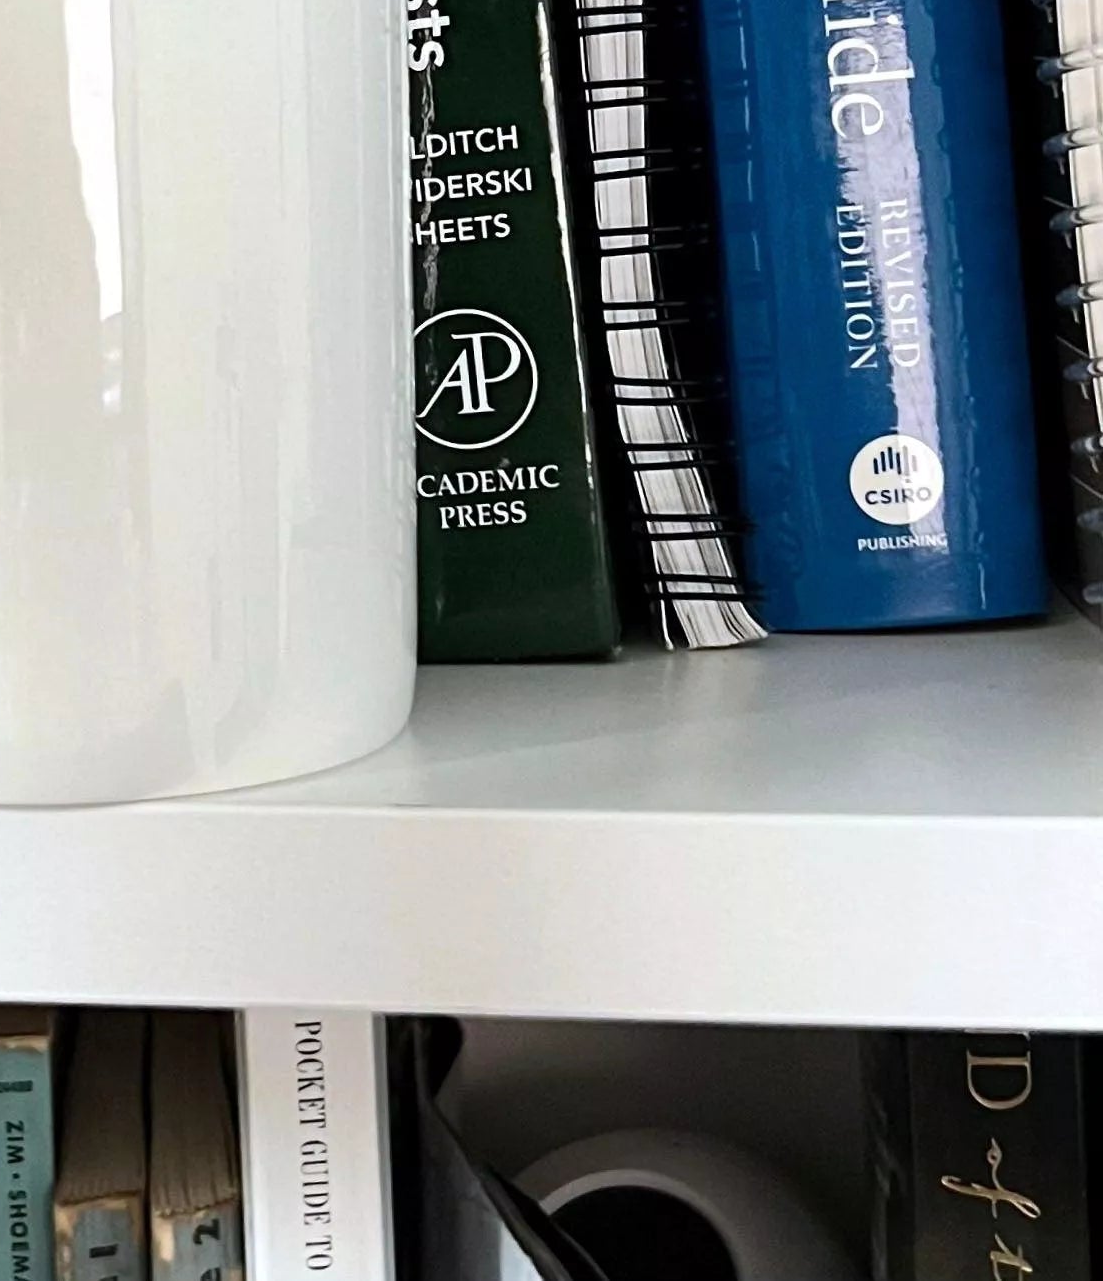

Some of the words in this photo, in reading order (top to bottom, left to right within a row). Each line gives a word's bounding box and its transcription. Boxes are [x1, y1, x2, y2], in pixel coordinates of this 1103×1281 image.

[409, 124, 520, 161] LDITCH
[414, 166, 533, 204] IDERSKI
[413, 212, 511, 246] HEETS
[835, 204, 878, 372] EDITION
[878, 197, 922, 369] REVISED
[416, 463, 562, 499] CADEMIC
[863, 486, 933, 506] CSIRO
[439, 499, 529, 530] PRESS
[857, 531, 949, 552] PUBLISHING
[293, 1020, 328, 1129] POCKET
[964, 1029, 1033, 1110] D
[4, 1120, 26, 1165] ZIM
[299, 1139, 332, 1228] GUIDE
[940, 1136, 1041, 1219] of
[303, 1233, 335, 1271] TO
